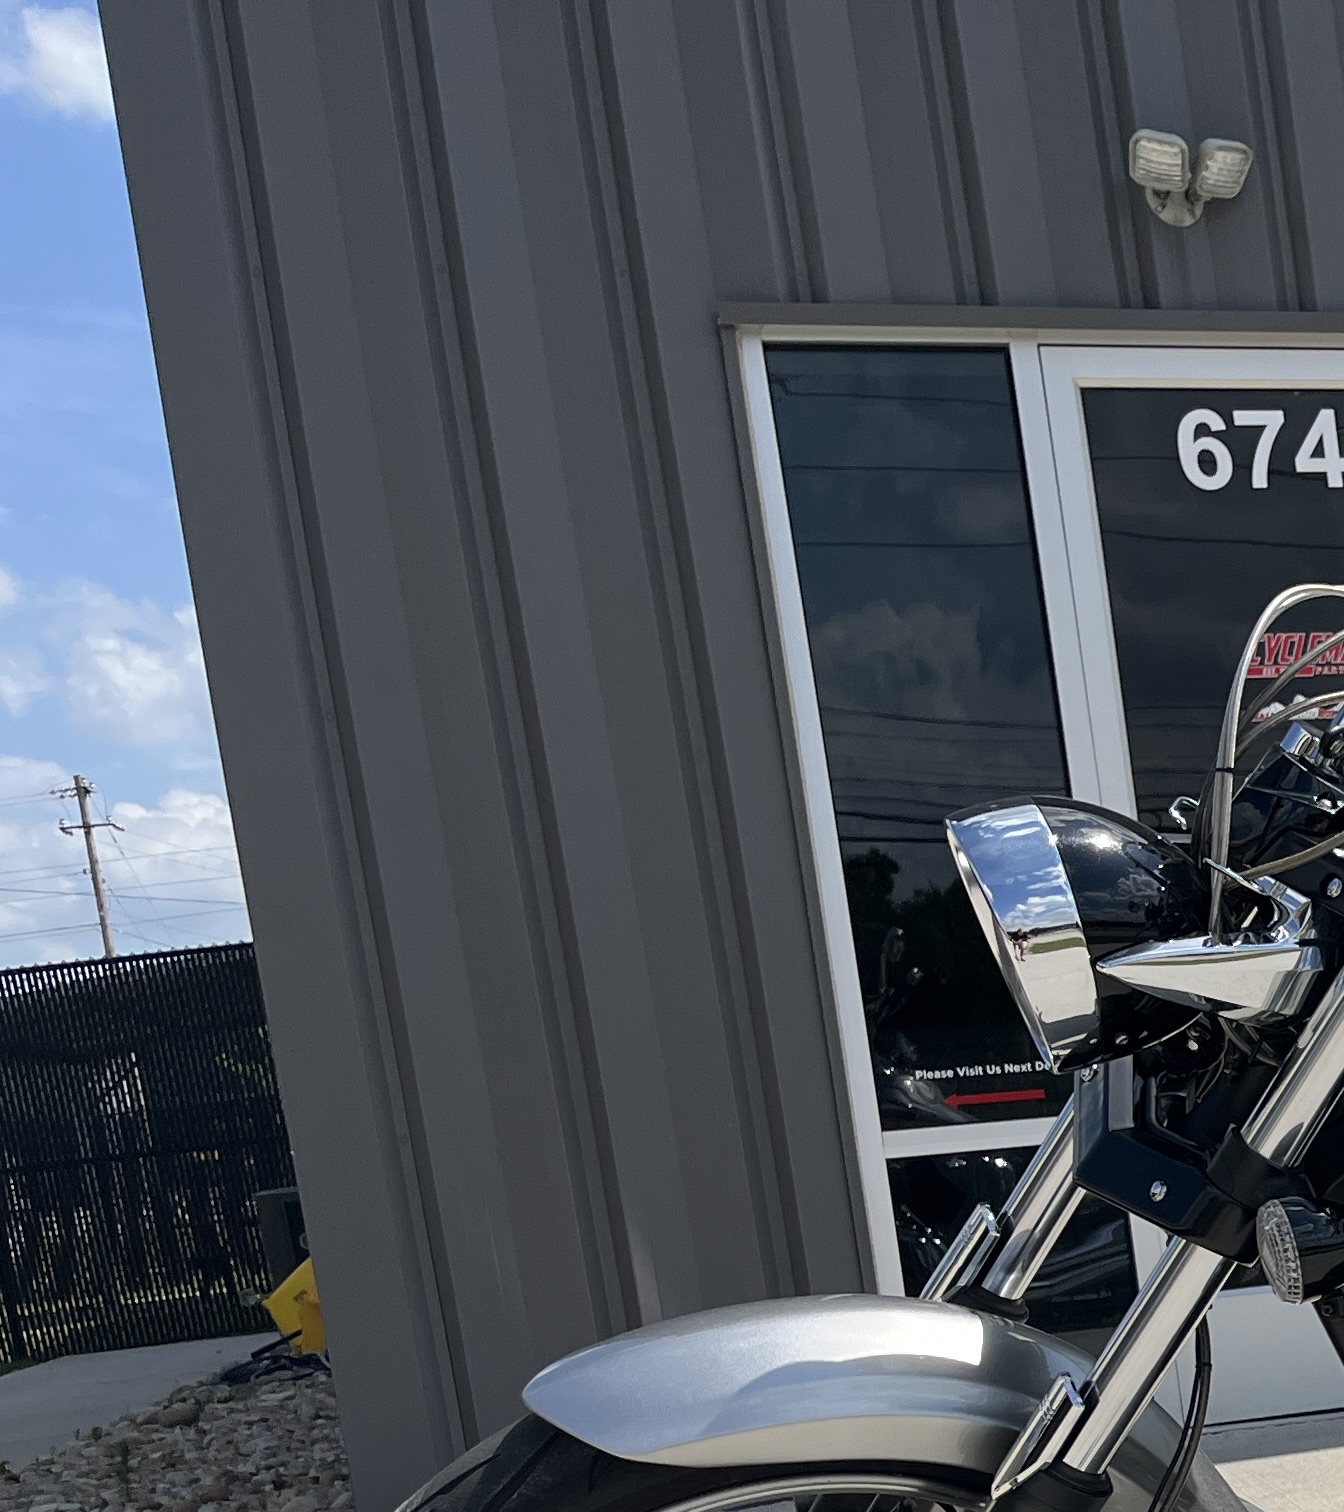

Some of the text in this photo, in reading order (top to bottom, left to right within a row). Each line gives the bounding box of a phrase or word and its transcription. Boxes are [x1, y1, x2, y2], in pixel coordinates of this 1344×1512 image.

[915, 1069, 954, 1080] Please
[956, 1065, 983, 1077] Visit
[986, 1064, 1002, 1075] Us
[1004, 1062, 1032, 1073] Next
